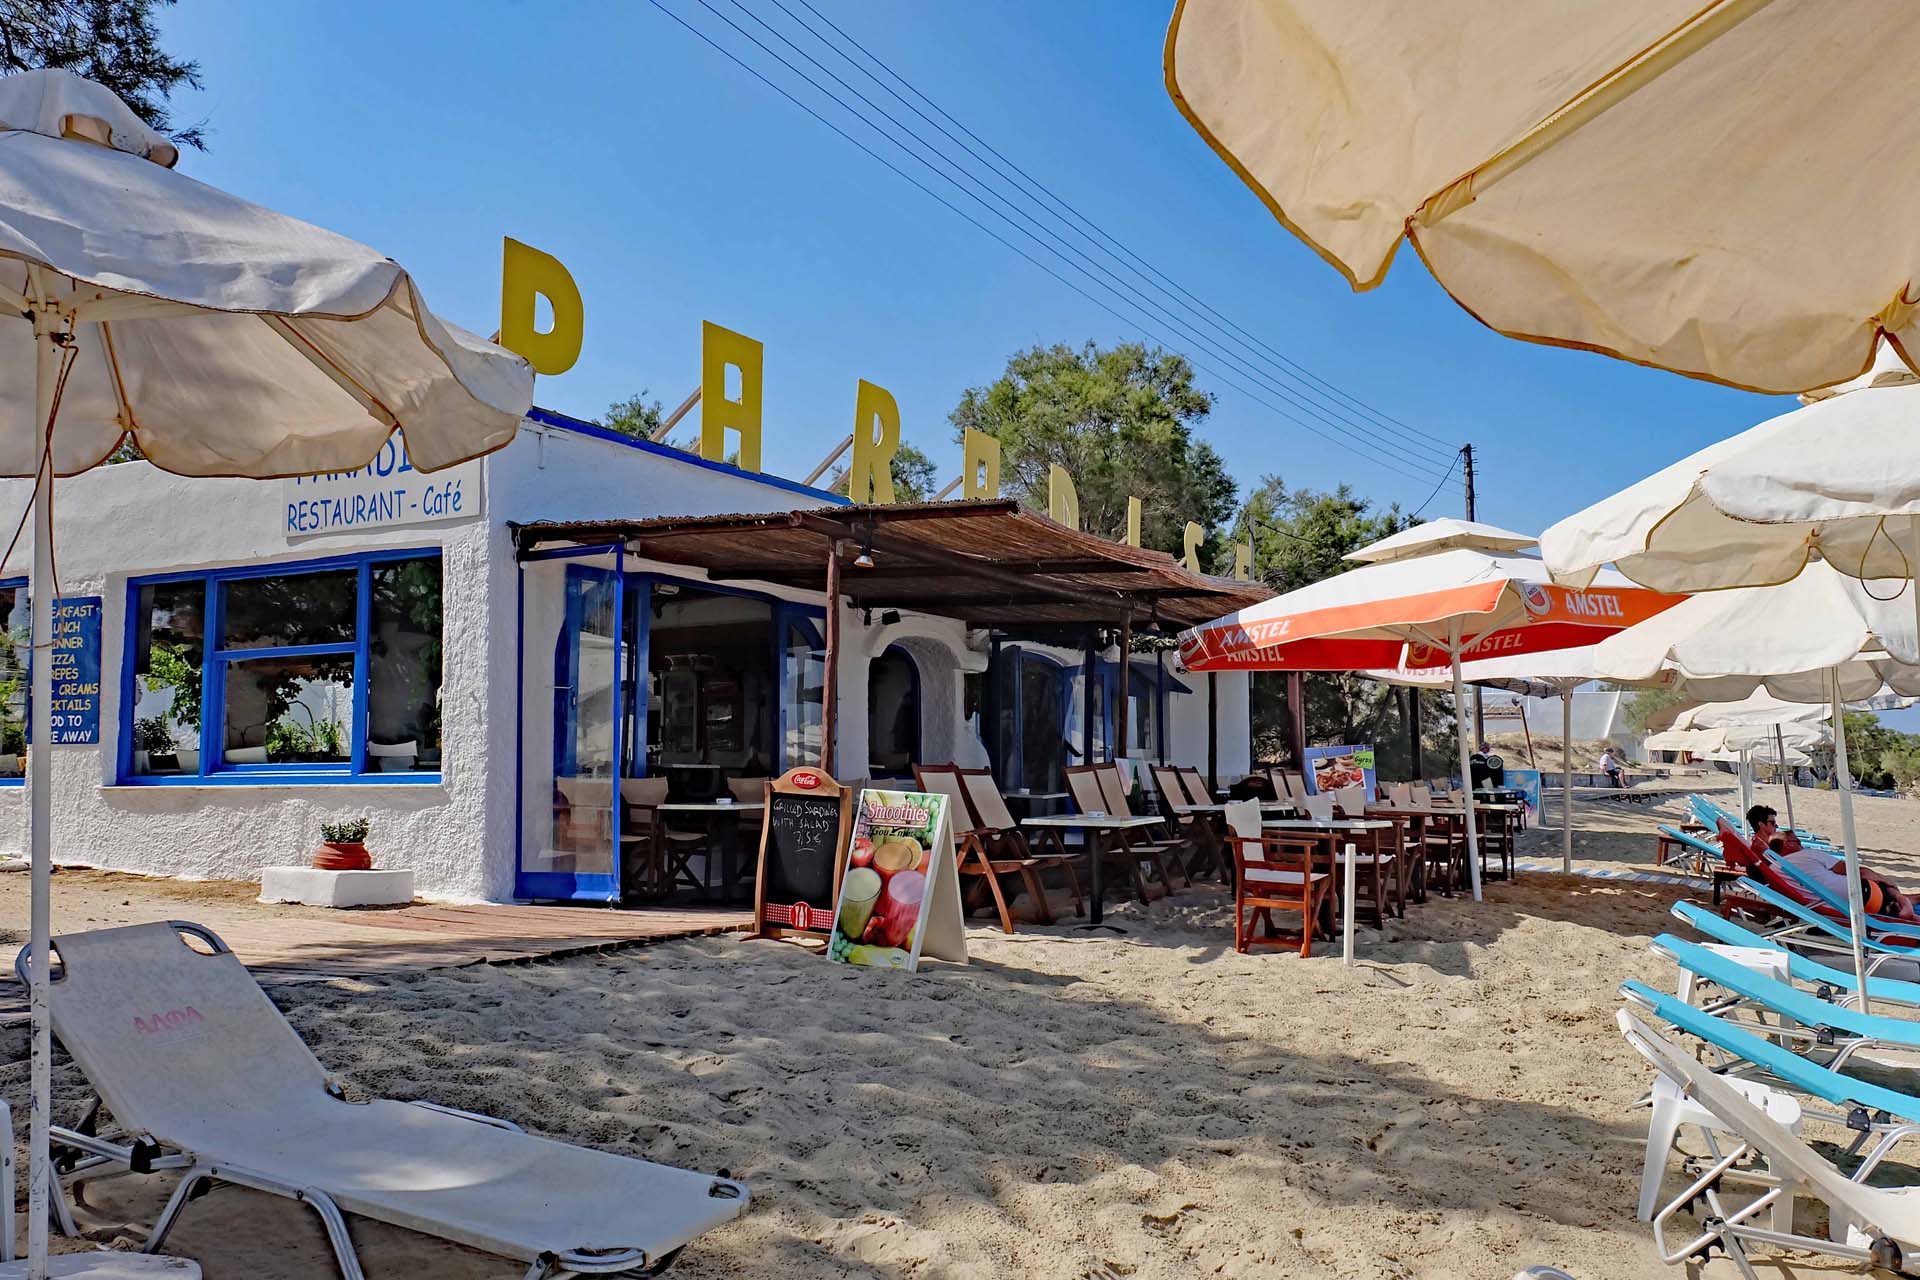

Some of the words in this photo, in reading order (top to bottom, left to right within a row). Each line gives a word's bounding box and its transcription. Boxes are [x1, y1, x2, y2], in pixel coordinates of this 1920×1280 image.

[287, 489, 406, 532] RESTAURANT
[423, 479, 463, 516] Café
[1565, 592, 1624, 617] AMSTEL
[52, 605, 94, 618] EAKFAST
[53, 621, 81, 634] UNCH
[1219, 620, 1292, 648] AMSTEL
[52, 637, 83, 649] INNER
[1464, 633, 1523, 654] MSTEL
[52, 654, 75, 665] IZZA
[52, 667, 79, 680] REPES
[58, 682, 99, 696] CREAMS
[51, 698, 92, 711] CKTAILS
[51, 715, 65, 727] OD
[67, 715, 83, 727] TO
[61, 730, 92, 743] AWAY
[867, 801, 929, 822] Smoothies
[800, 818, 829, 832] SALAD
